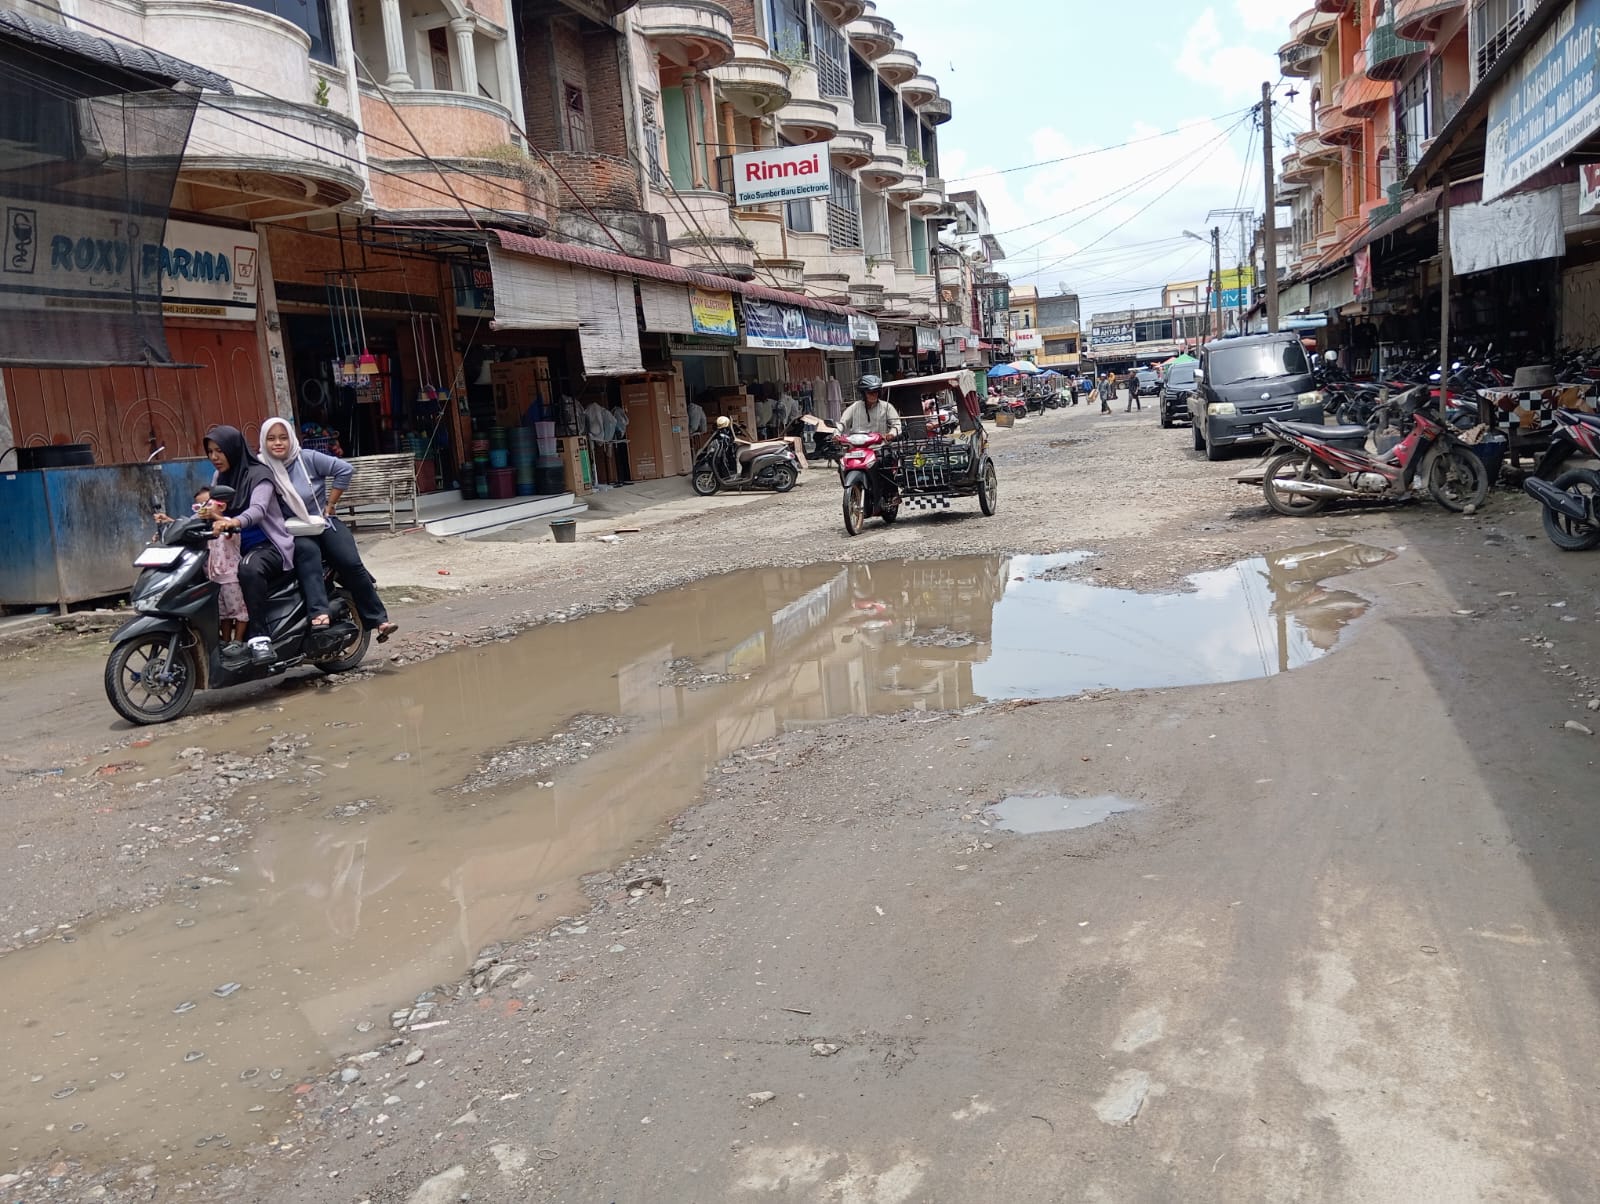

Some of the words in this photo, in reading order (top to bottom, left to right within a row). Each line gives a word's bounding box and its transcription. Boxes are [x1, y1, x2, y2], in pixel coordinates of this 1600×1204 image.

[1523, 54, 1562, 115] Lhoksukon
[1565, 23, 1593, 77] Motor
[1556, 83, 1573, 121] Mobil
[1574, 66, 1593, 106] Bekas
[745, 154, 819, 182] Rinnai
[739, 193, 756, 201] Toko
[755, 190, 780, 199] Sumber
[781, 187, 796, 196] Baru
[797, 183, 829, 194] Electronic
[50, 234, 129, 275] ROXY
[142, 243, 232, 285] FARMA
[1280, 432, 1311, 453] HONDA
